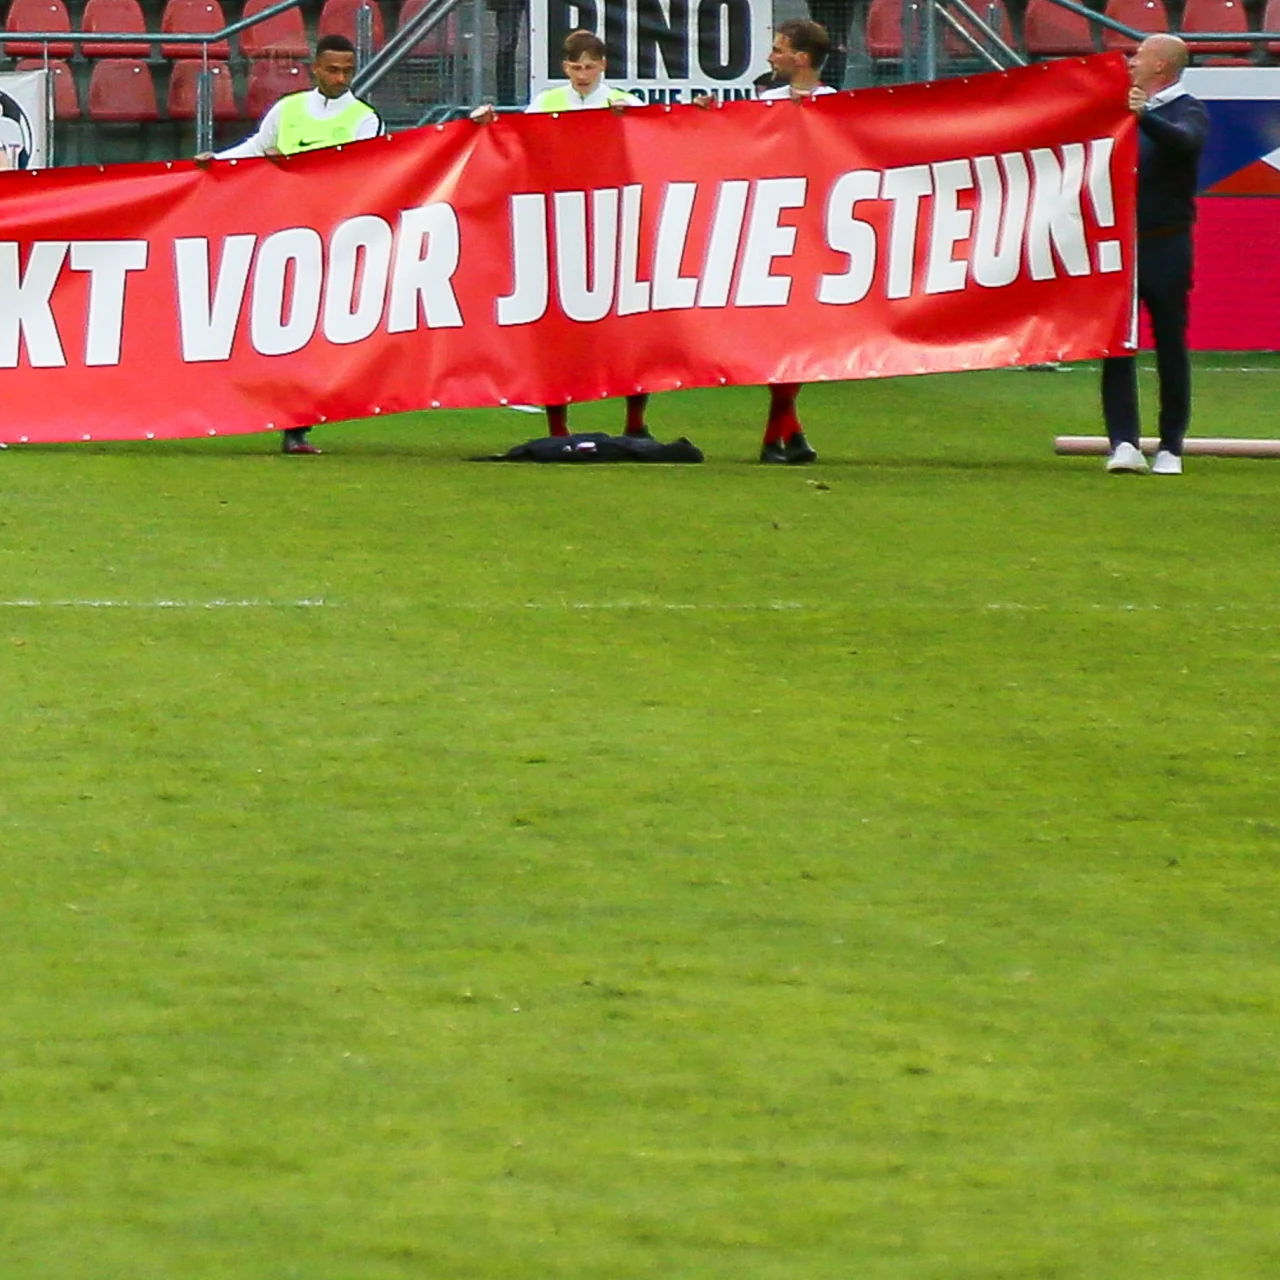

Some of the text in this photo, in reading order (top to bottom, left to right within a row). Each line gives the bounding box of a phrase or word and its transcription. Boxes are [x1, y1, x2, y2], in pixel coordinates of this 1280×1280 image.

[173, 200, 465, 363] VOOR
[496, 175, 807, 326] JULLIE
[817, 137, 1122, 306] STEUN!
